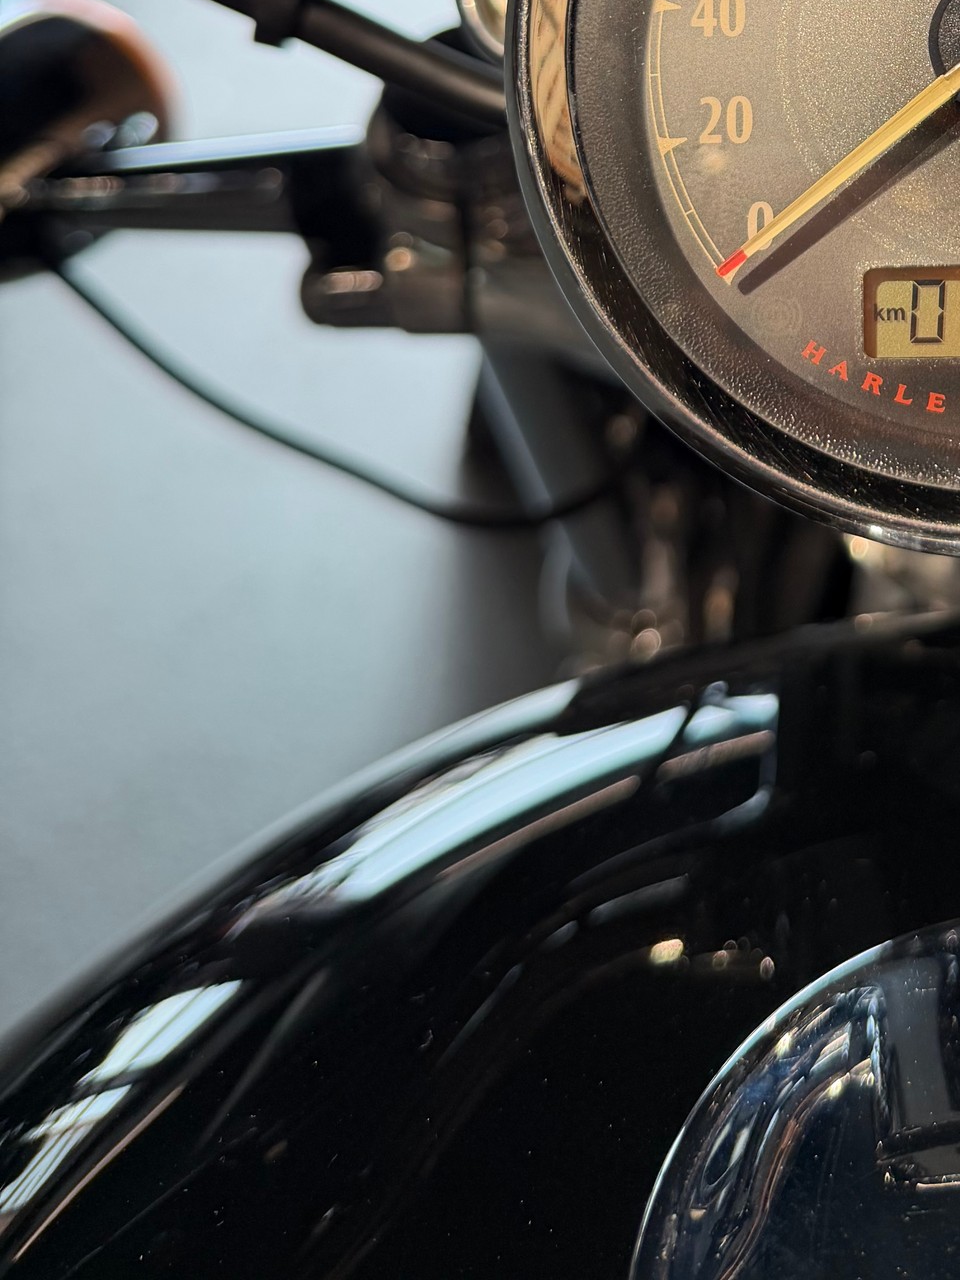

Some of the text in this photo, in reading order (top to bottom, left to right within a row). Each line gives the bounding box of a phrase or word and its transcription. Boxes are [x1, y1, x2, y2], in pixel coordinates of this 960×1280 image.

[699, 96, 753, 144] 20
[747, 201, 774, 250] 0
[873, 304, 906, 321] km
